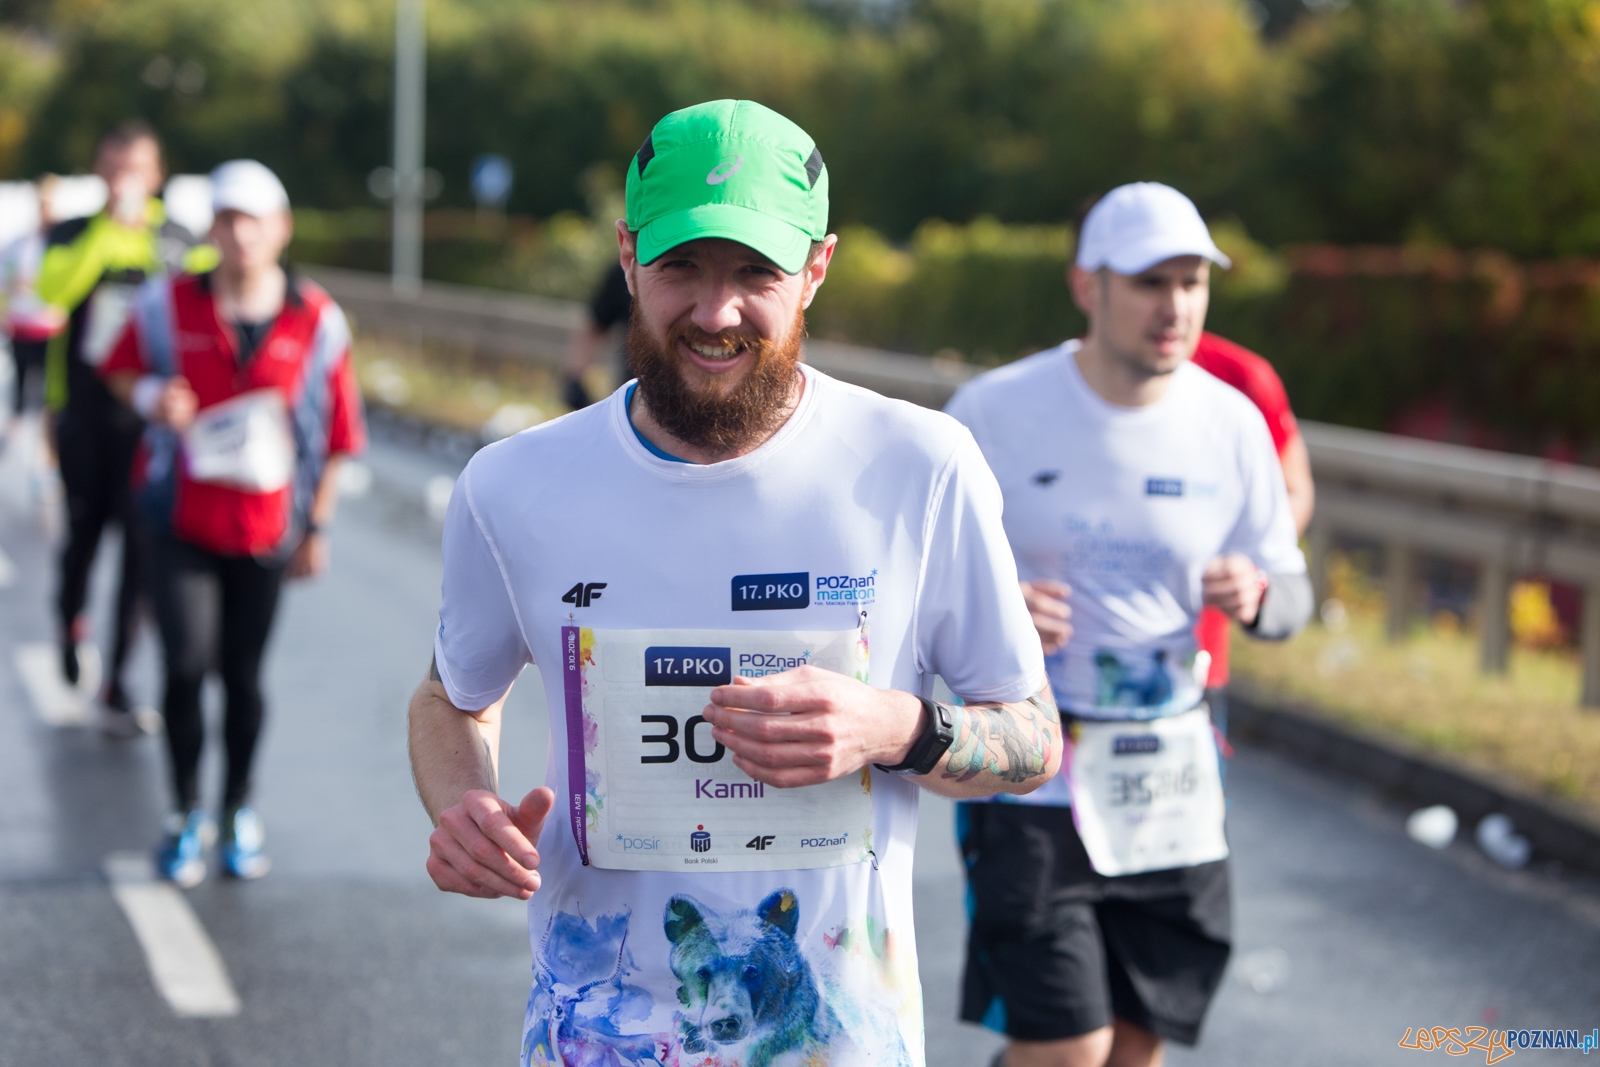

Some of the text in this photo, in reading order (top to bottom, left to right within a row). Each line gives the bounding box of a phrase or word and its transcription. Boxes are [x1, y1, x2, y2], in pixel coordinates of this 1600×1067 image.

[561, 582, 607, 608] 4F
[817, 588, 875, 601] maraton
[695, 779, 764, 799] Kamil
[574, 793, 582, 810] M31
[745, 835, 776, 850] 4F
[701, 857, 718, 865] Polski
